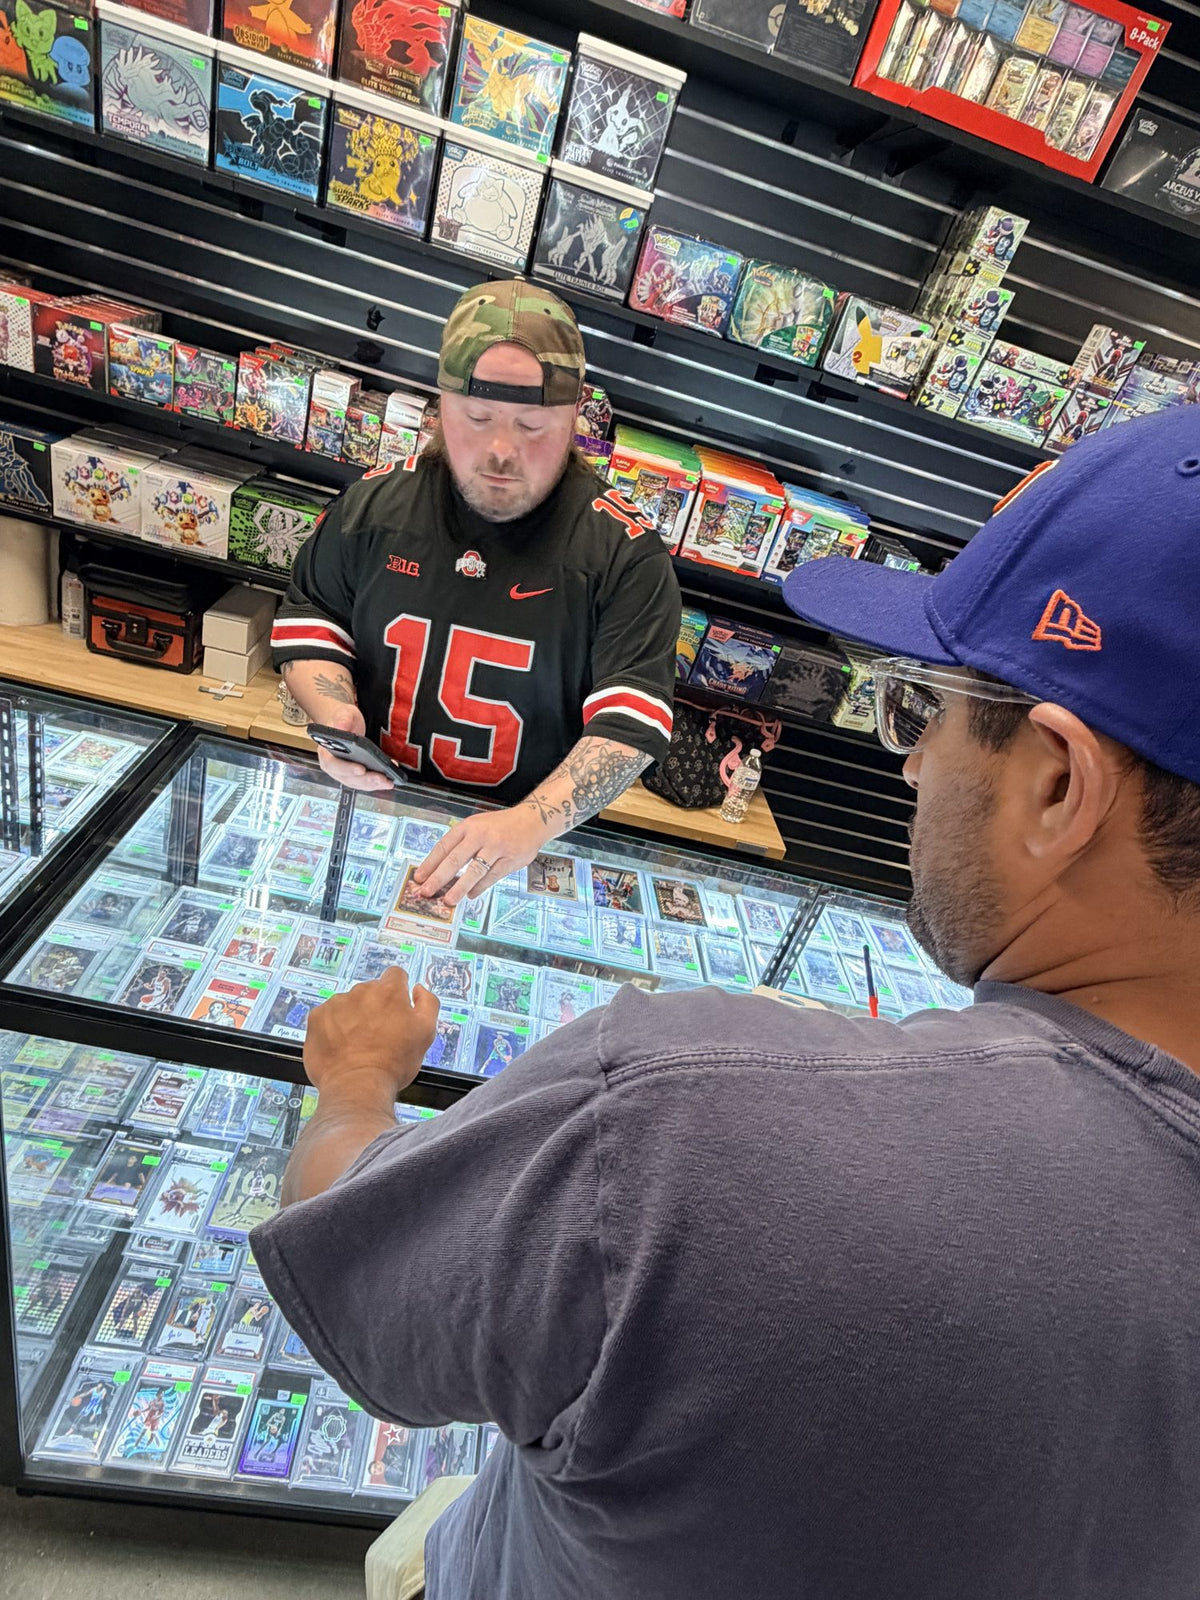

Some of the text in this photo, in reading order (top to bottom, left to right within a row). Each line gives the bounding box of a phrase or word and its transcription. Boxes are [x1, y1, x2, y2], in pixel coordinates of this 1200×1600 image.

[234, 25, 269, 46] OBSIDIAN
[1129, 27, 1160, 50] 8-Pack
[360, 77, 421, 104] ELITE TRAINER BOX
[108, 113, 150, 134] TEMPORAL
[111, 122, 147, 139] FORCES
[238, 157, 259, 171] BOLT
[1163, 180, 1193, 197] ARCEUS
[336, 193, 371, 211] SPARKS
[708, 677, 748, 695] CHAOS RISING
[380, 613, 535, 787] 15
[183, 1445, 228, 1460] LEADERS
